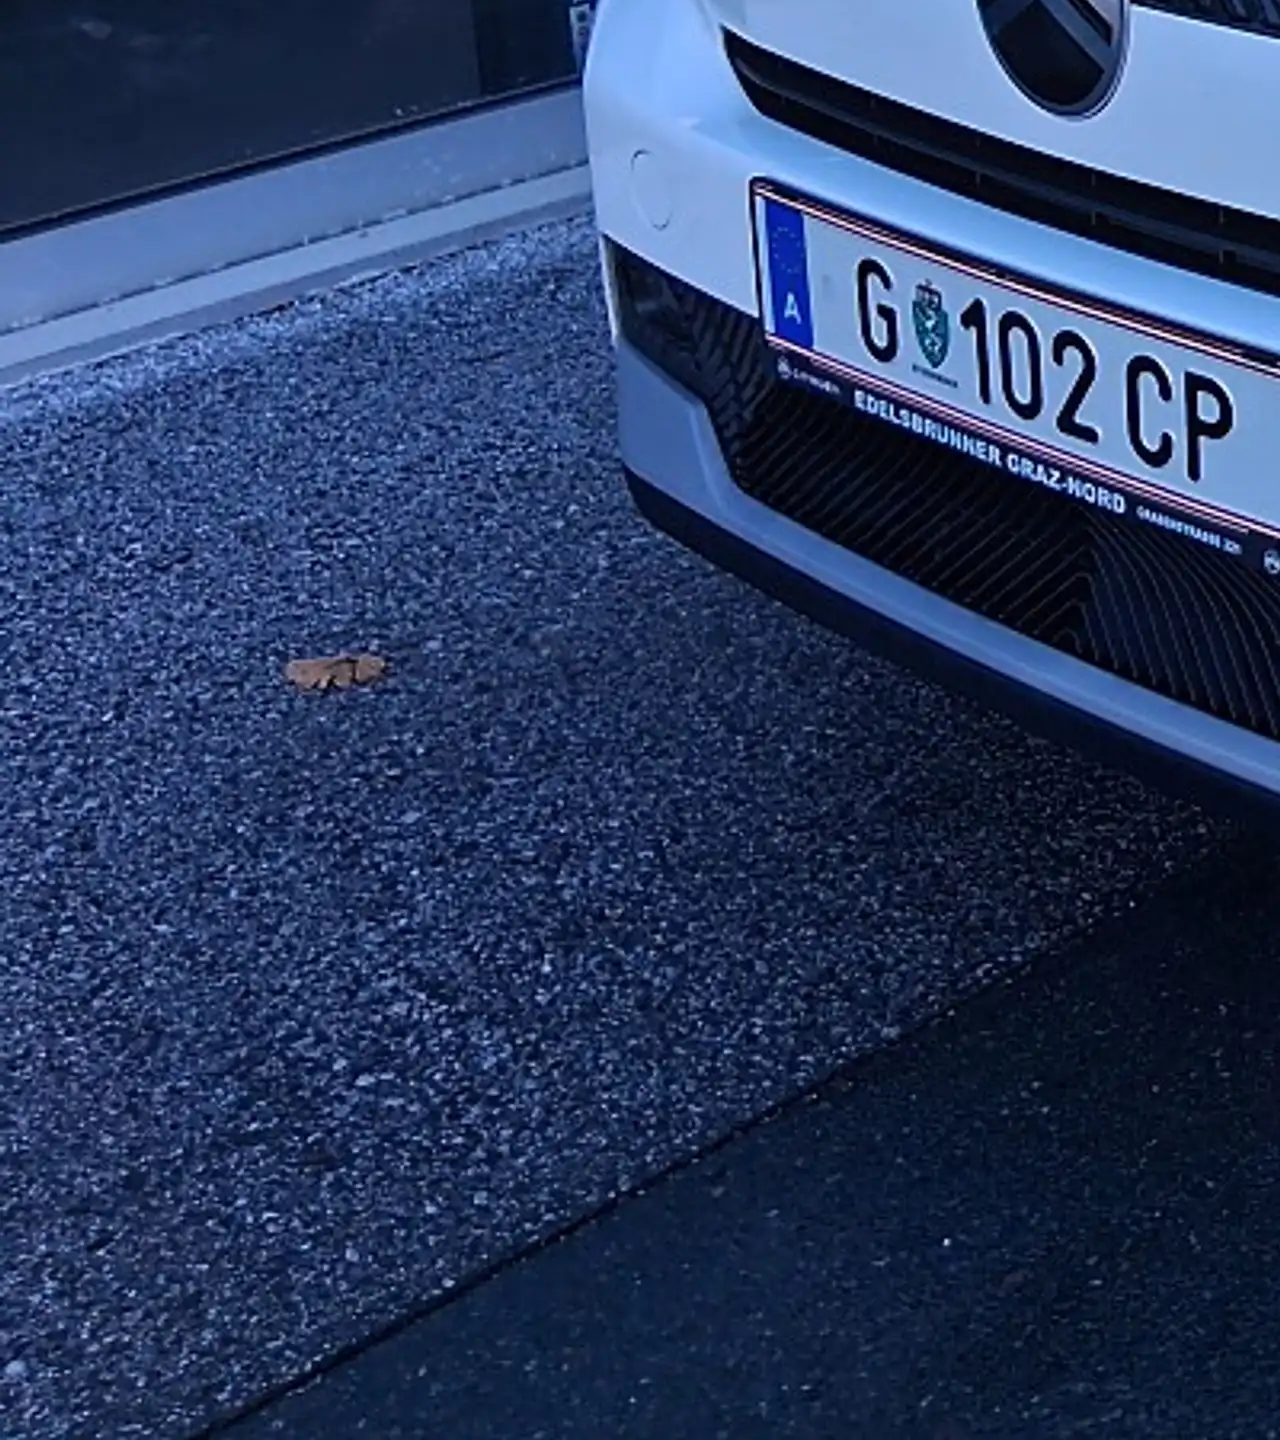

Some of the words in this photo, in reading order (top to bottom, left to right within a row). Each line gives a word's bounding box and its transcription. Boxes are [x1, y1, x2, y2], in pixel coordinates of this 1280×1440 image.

[783, 292, 802, 324] A
[856, 258, 898, 362] G
[960, 298, 1100, 445] 102
[1126, 355, 1234, 482] CP
[854, 389, 1003, 468] EDELSBRUNNER
[1007, 453, 1126, 514] GRAZ-NORD
